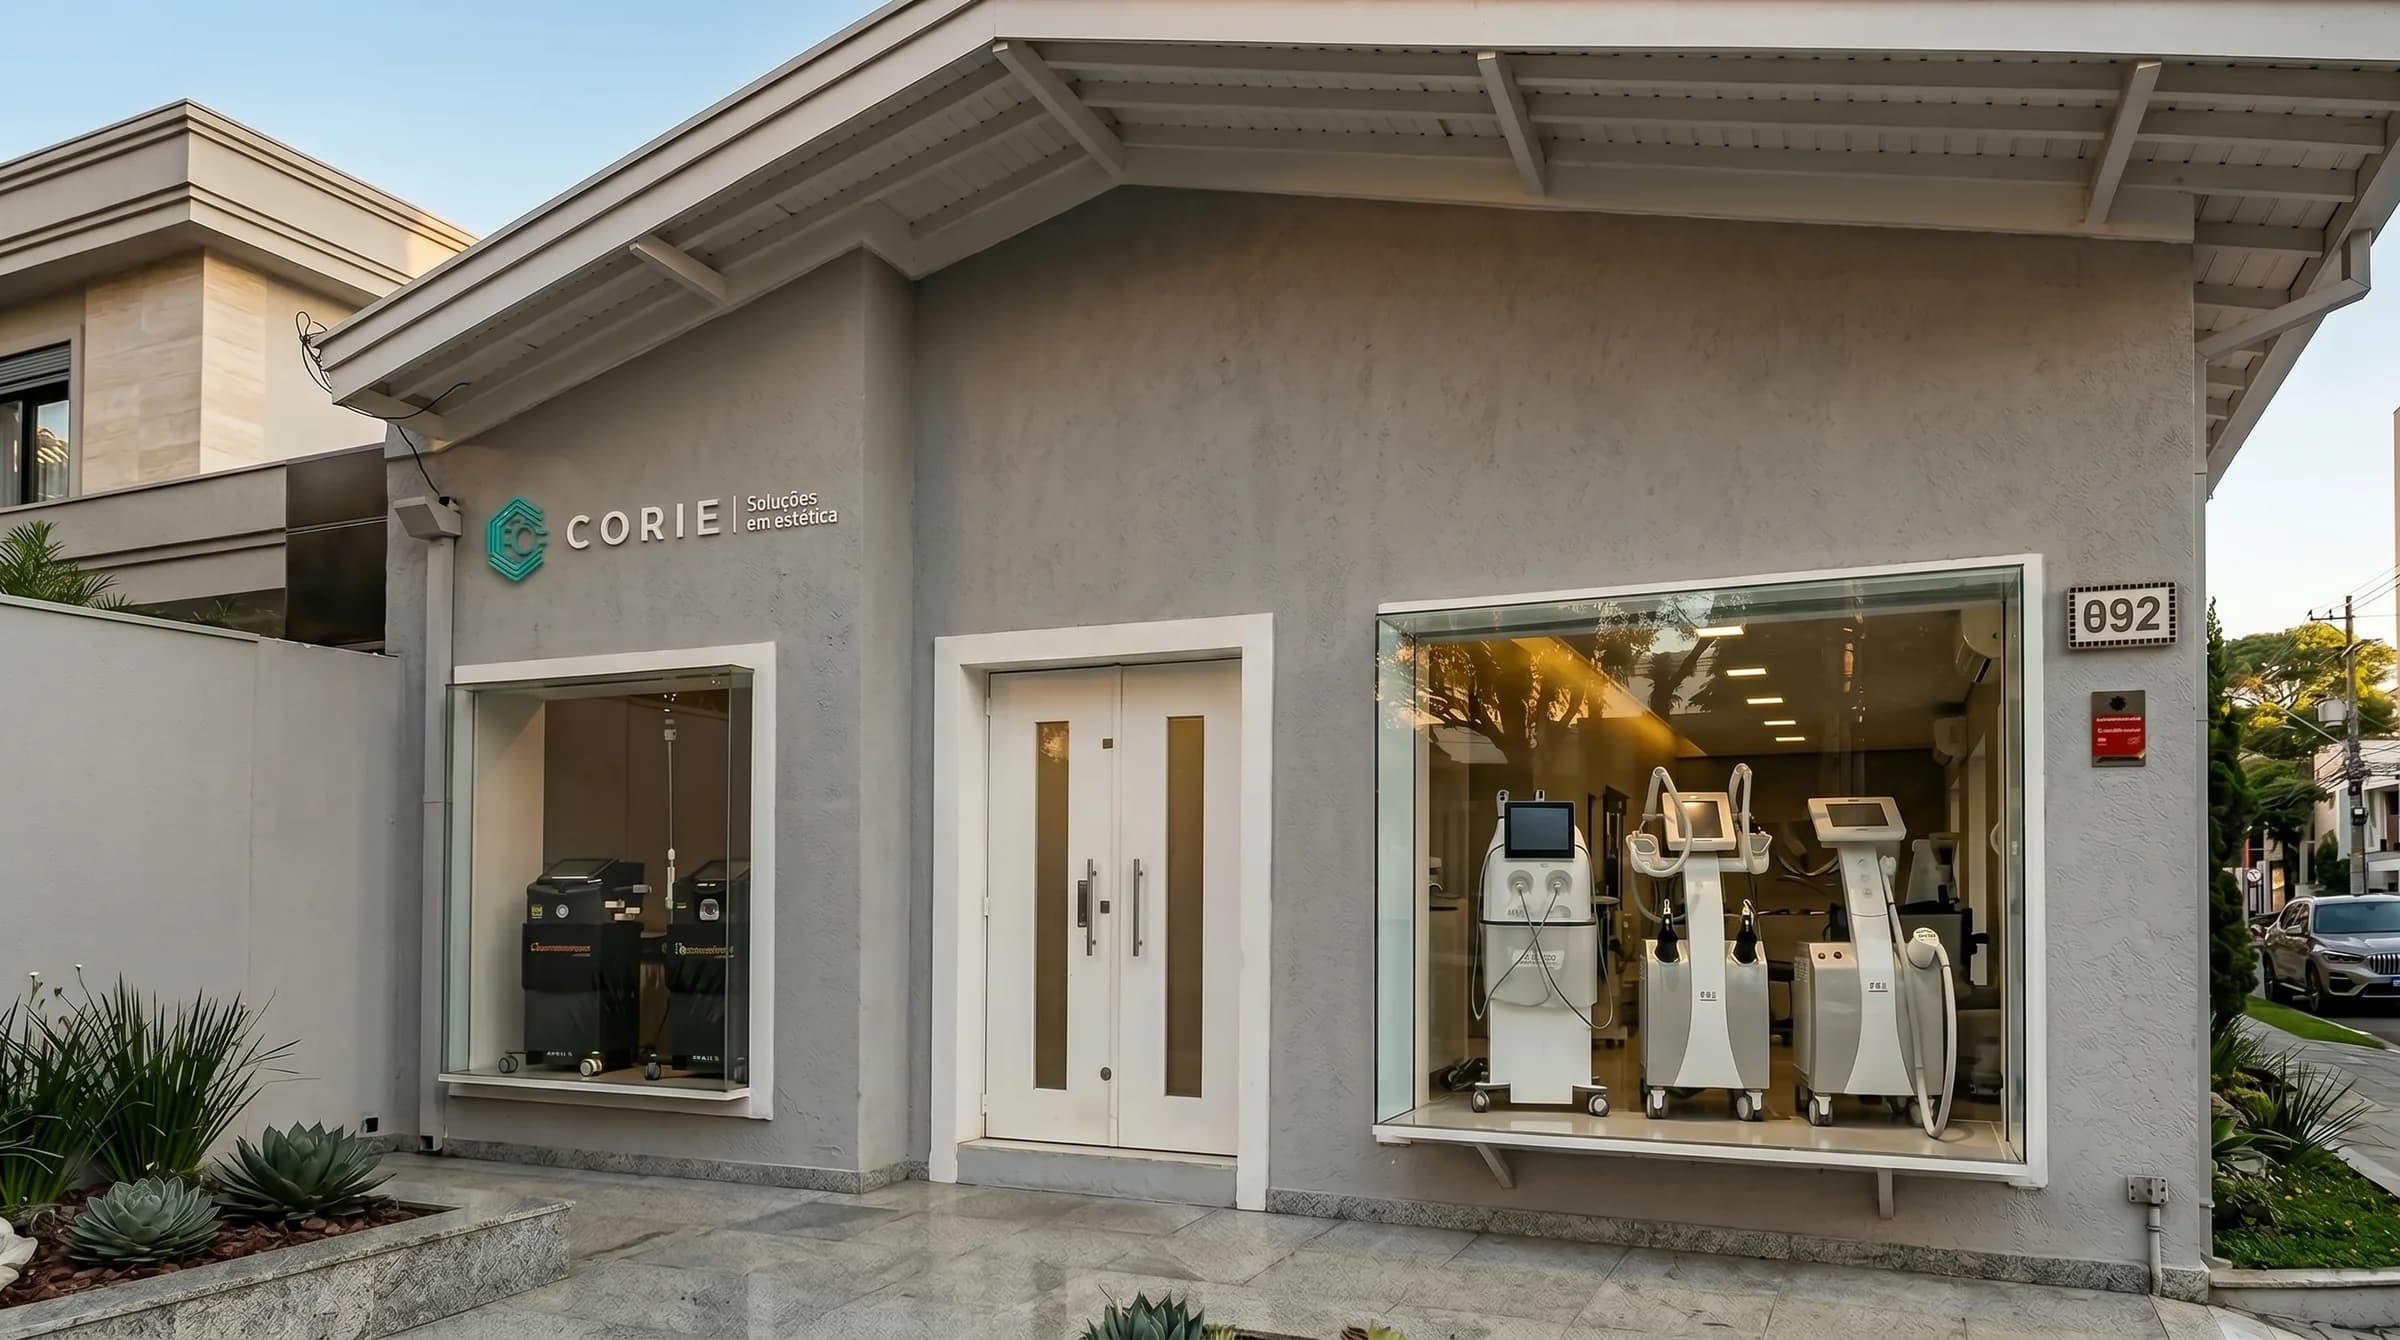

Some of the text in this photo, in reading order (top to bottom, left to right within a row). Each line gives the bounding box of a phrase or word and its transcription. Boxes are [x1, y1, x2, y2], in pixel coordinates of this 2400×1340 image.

[746, 490, 818, 513] Soluções
[566, 498, 721, 550] CORIE
[746, 507, 838, 531] em estética
